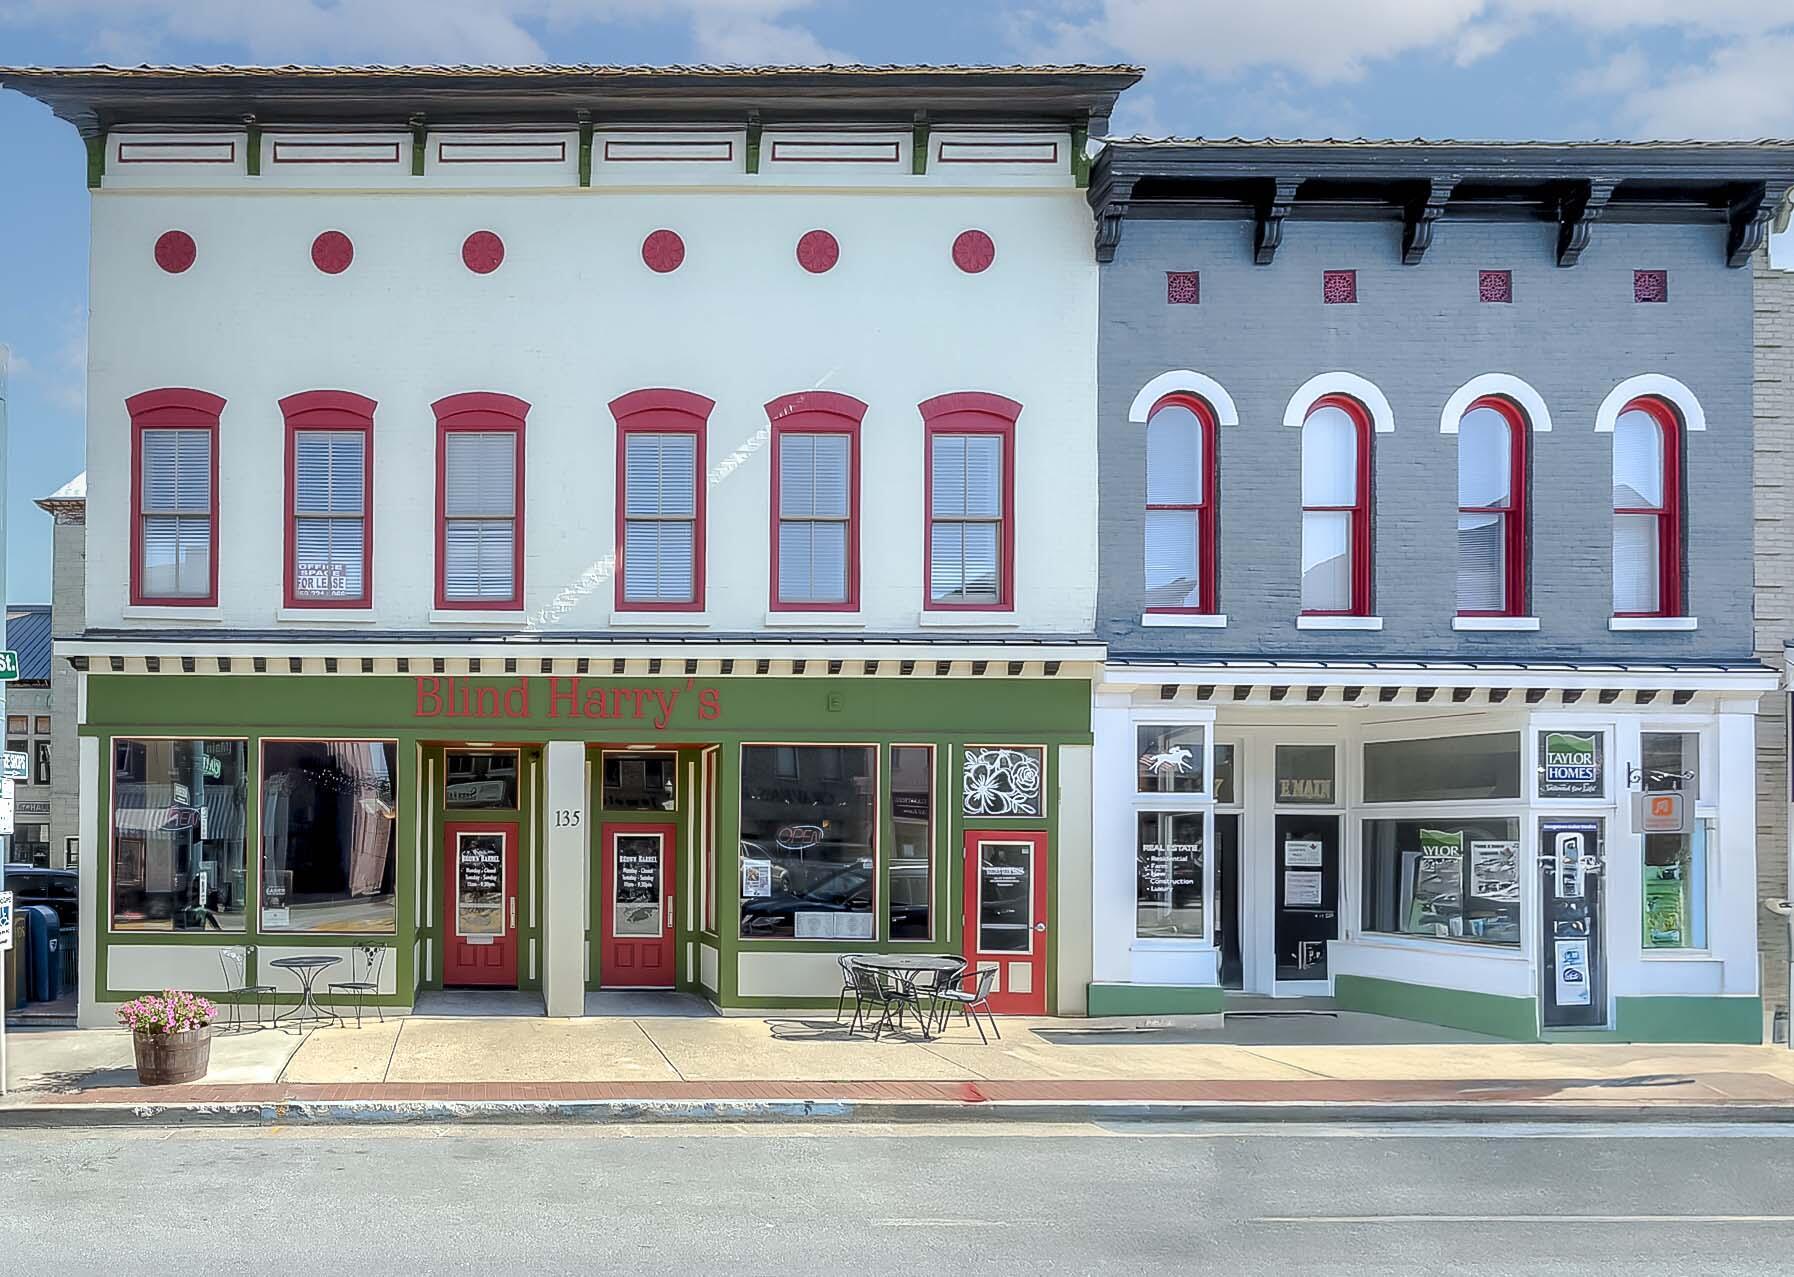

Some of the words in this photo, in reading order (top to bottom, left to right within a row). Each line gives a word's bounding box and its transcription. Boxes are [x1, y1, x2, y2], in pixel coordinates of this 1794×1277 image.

[316, 578, 345, 589] LESE
[414, 676, 530, 718] Blind
[546, 676, 721, 729] Harry's
[1548, 752, 1592, 764] TAYLOR
[1549, 767, 1593, 779] HOMES
[555, 810, 581, 827] 135
[779, 827, 821, 843] OPEN
